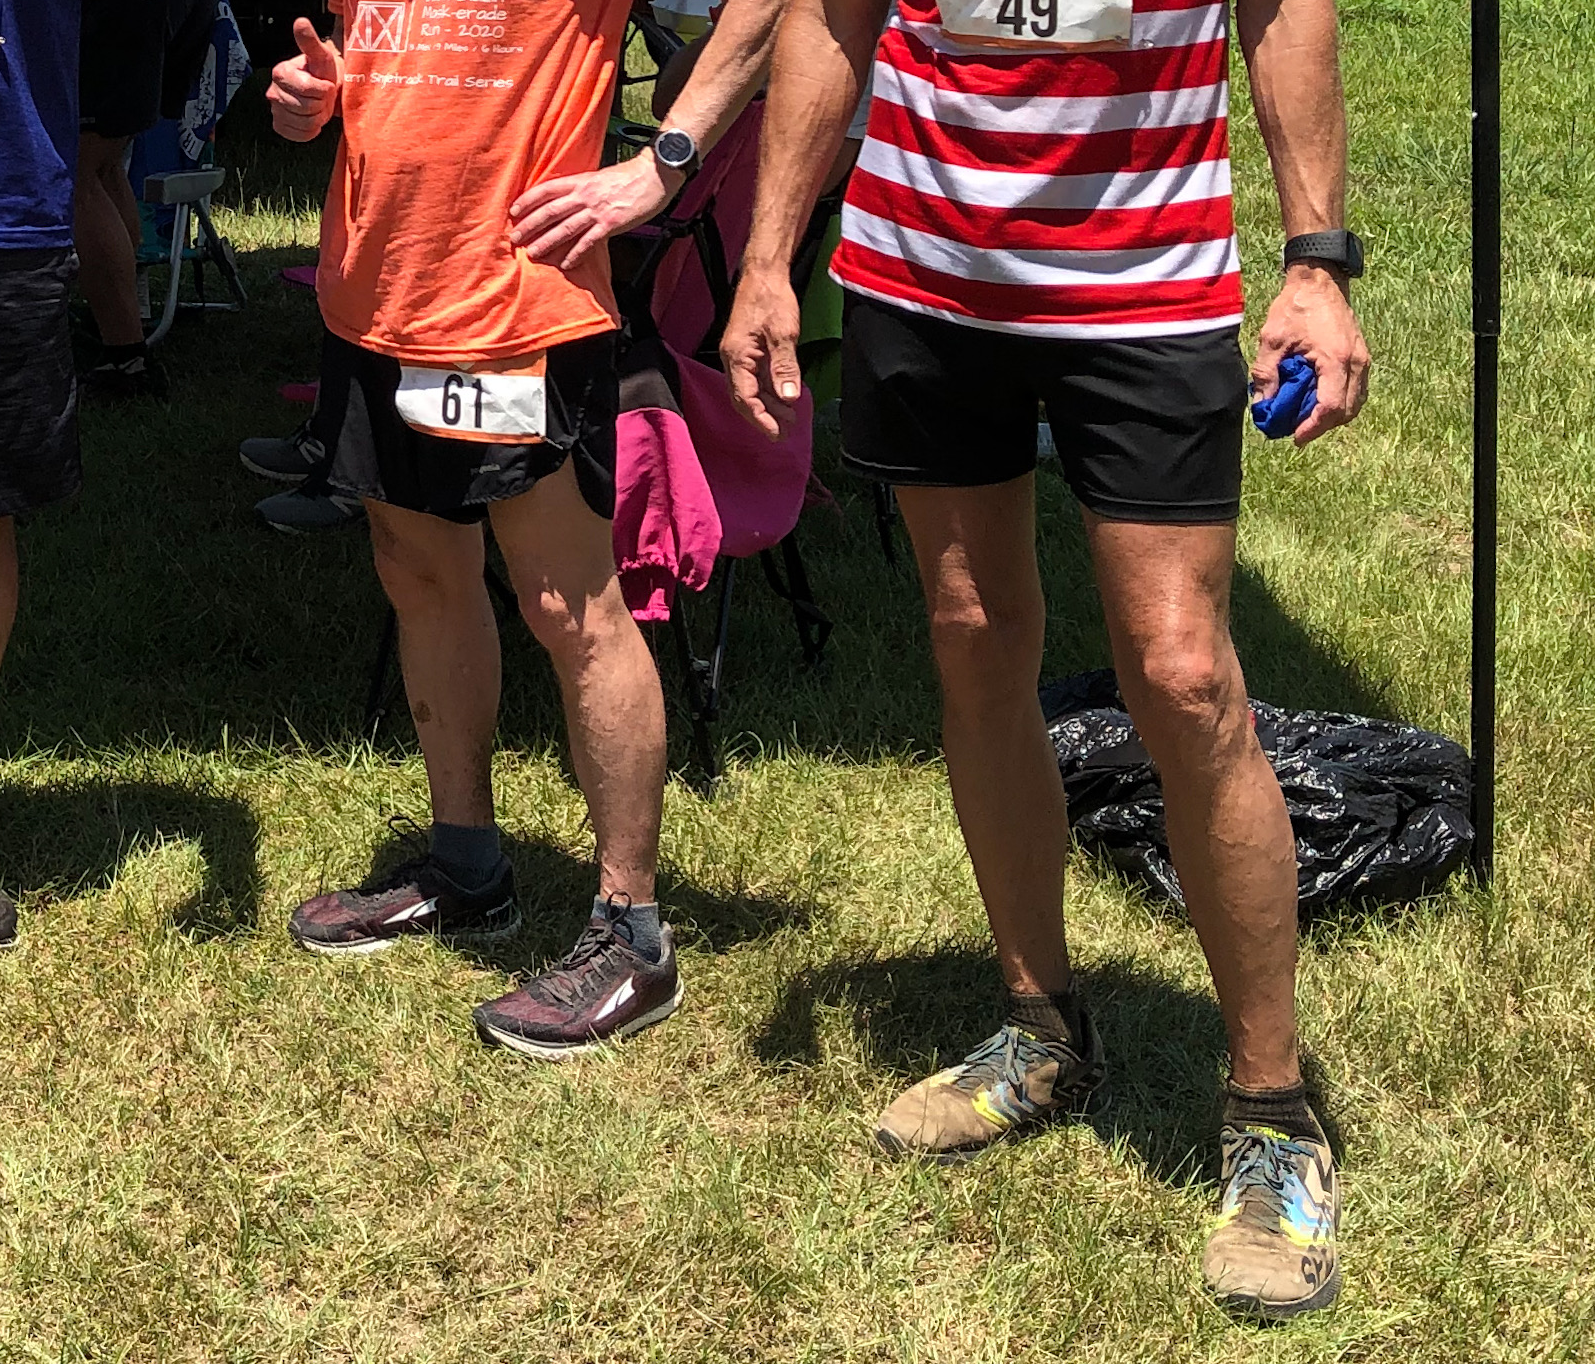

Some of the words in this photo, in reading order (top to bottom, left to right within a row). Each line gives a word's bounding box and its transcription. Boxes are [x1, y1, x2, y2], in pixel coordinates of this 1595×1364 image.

[458, 24, 504, 37] 2020
[427, 74, 459, 86] Trail
[464, 76, 514, 88] Series
[442, 374, 482, 428] 61
